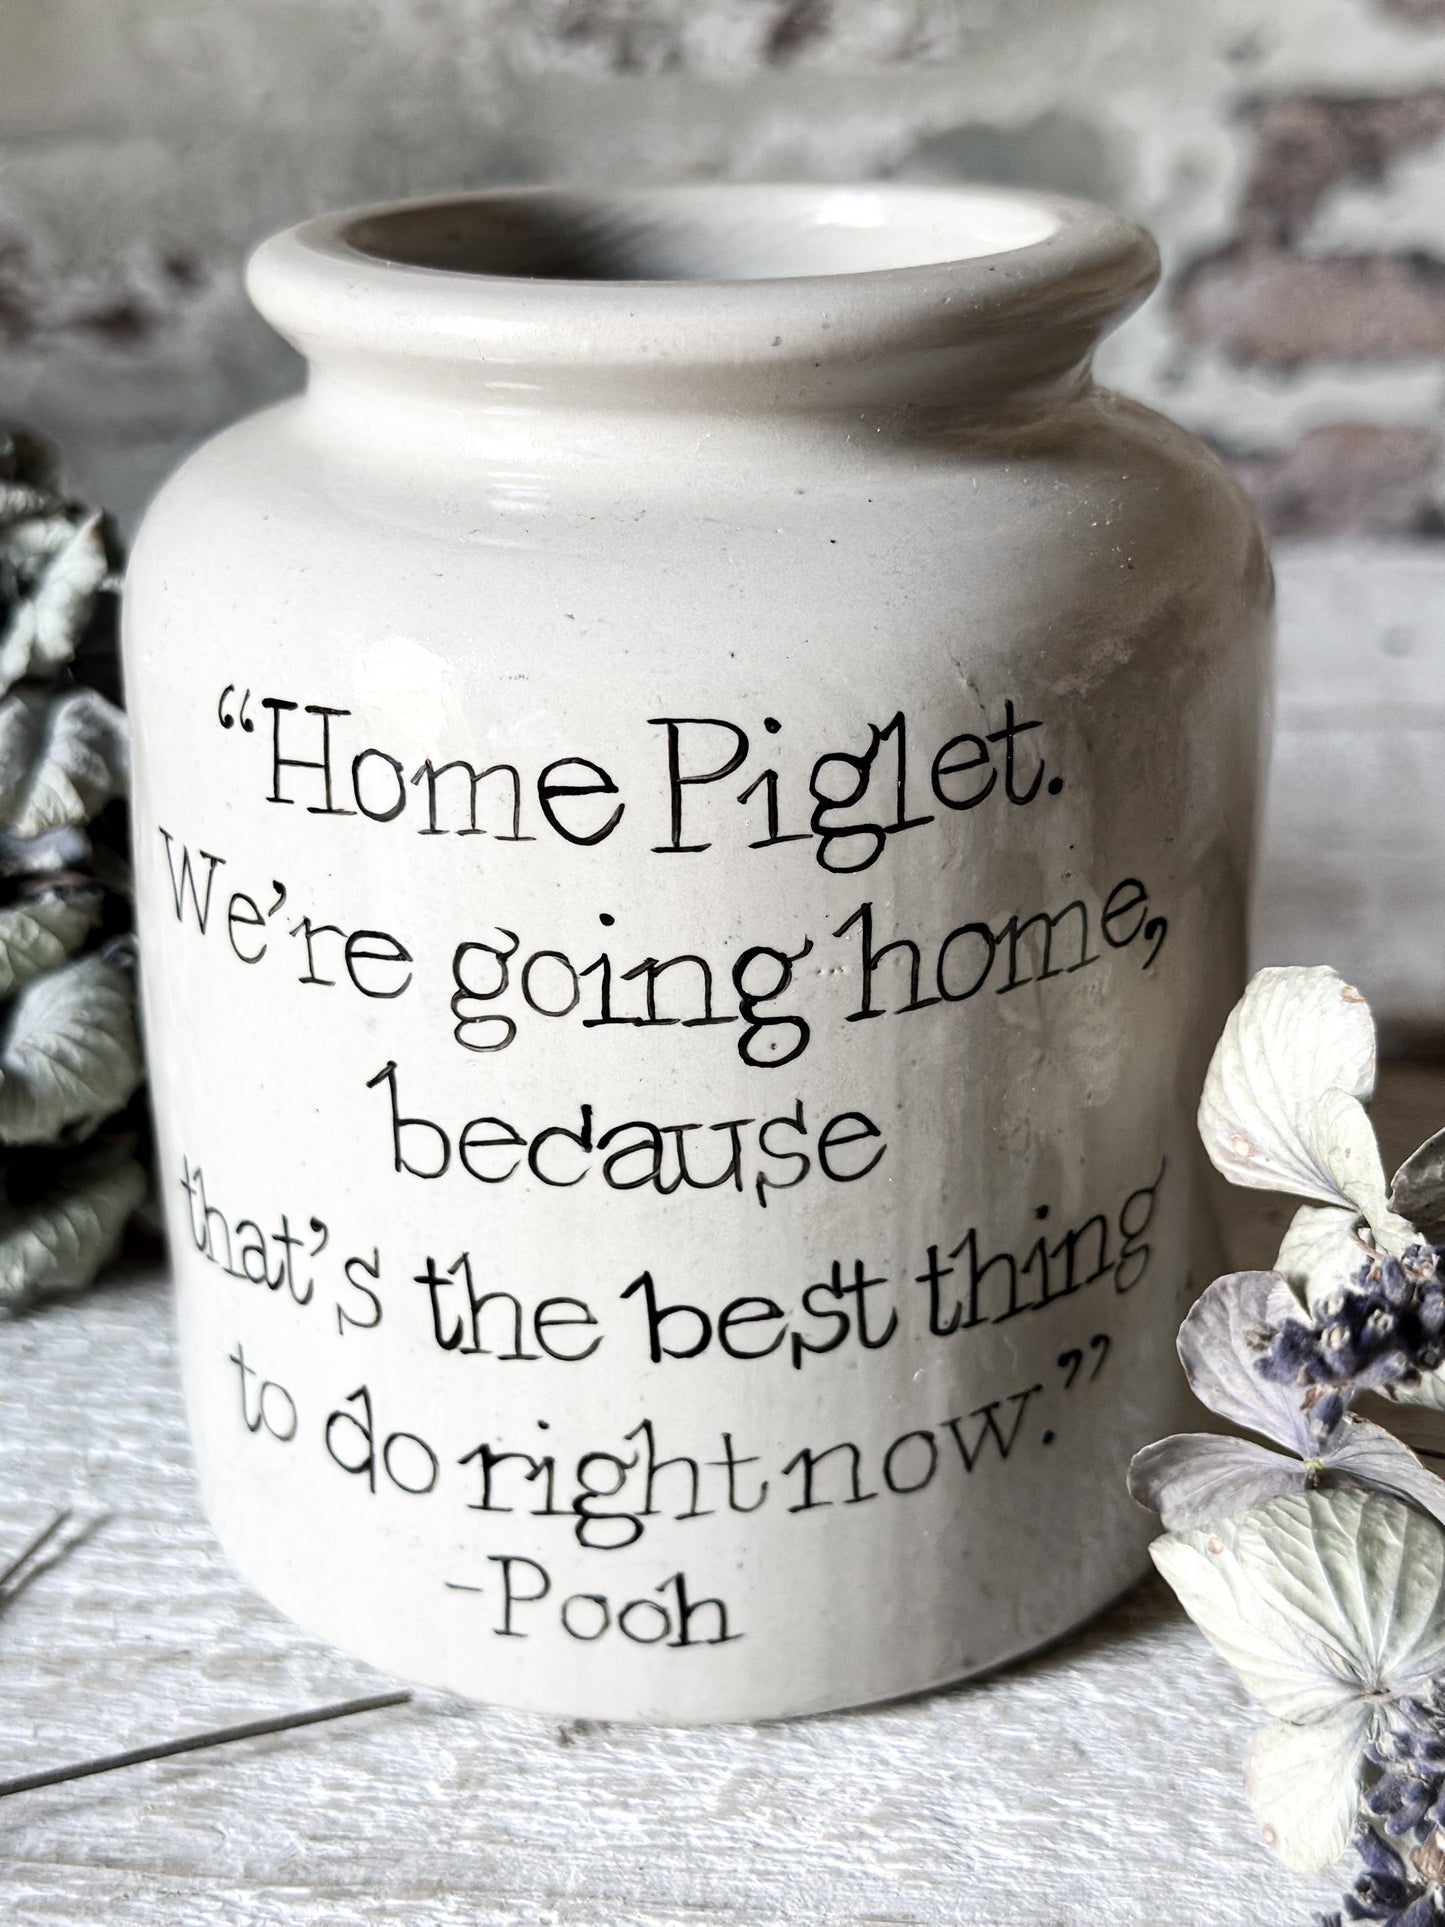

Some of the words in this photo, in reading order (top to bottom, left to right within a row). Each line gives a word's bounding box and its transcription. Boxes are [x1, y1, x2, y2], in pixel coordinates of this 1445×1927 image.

[647, 700, 1063, 873] Piglet.
[159, 826, 413, 998] We’re
[451, 913, 813, 1068] going
[832, 878, 1167, 1022] home,
[366, 1060, 887, 1208] because
[181, 1154, 383, 1335] that’s
[413, 1251, 605, 1362] the
[620, 1259, 897, 1369] best
[916, 1153, 1167, 1336] thing
[229, 1343, 298, 1442] to
[325, 1384, 439, 1494] do
[458, 1418, 768, 1549] right
